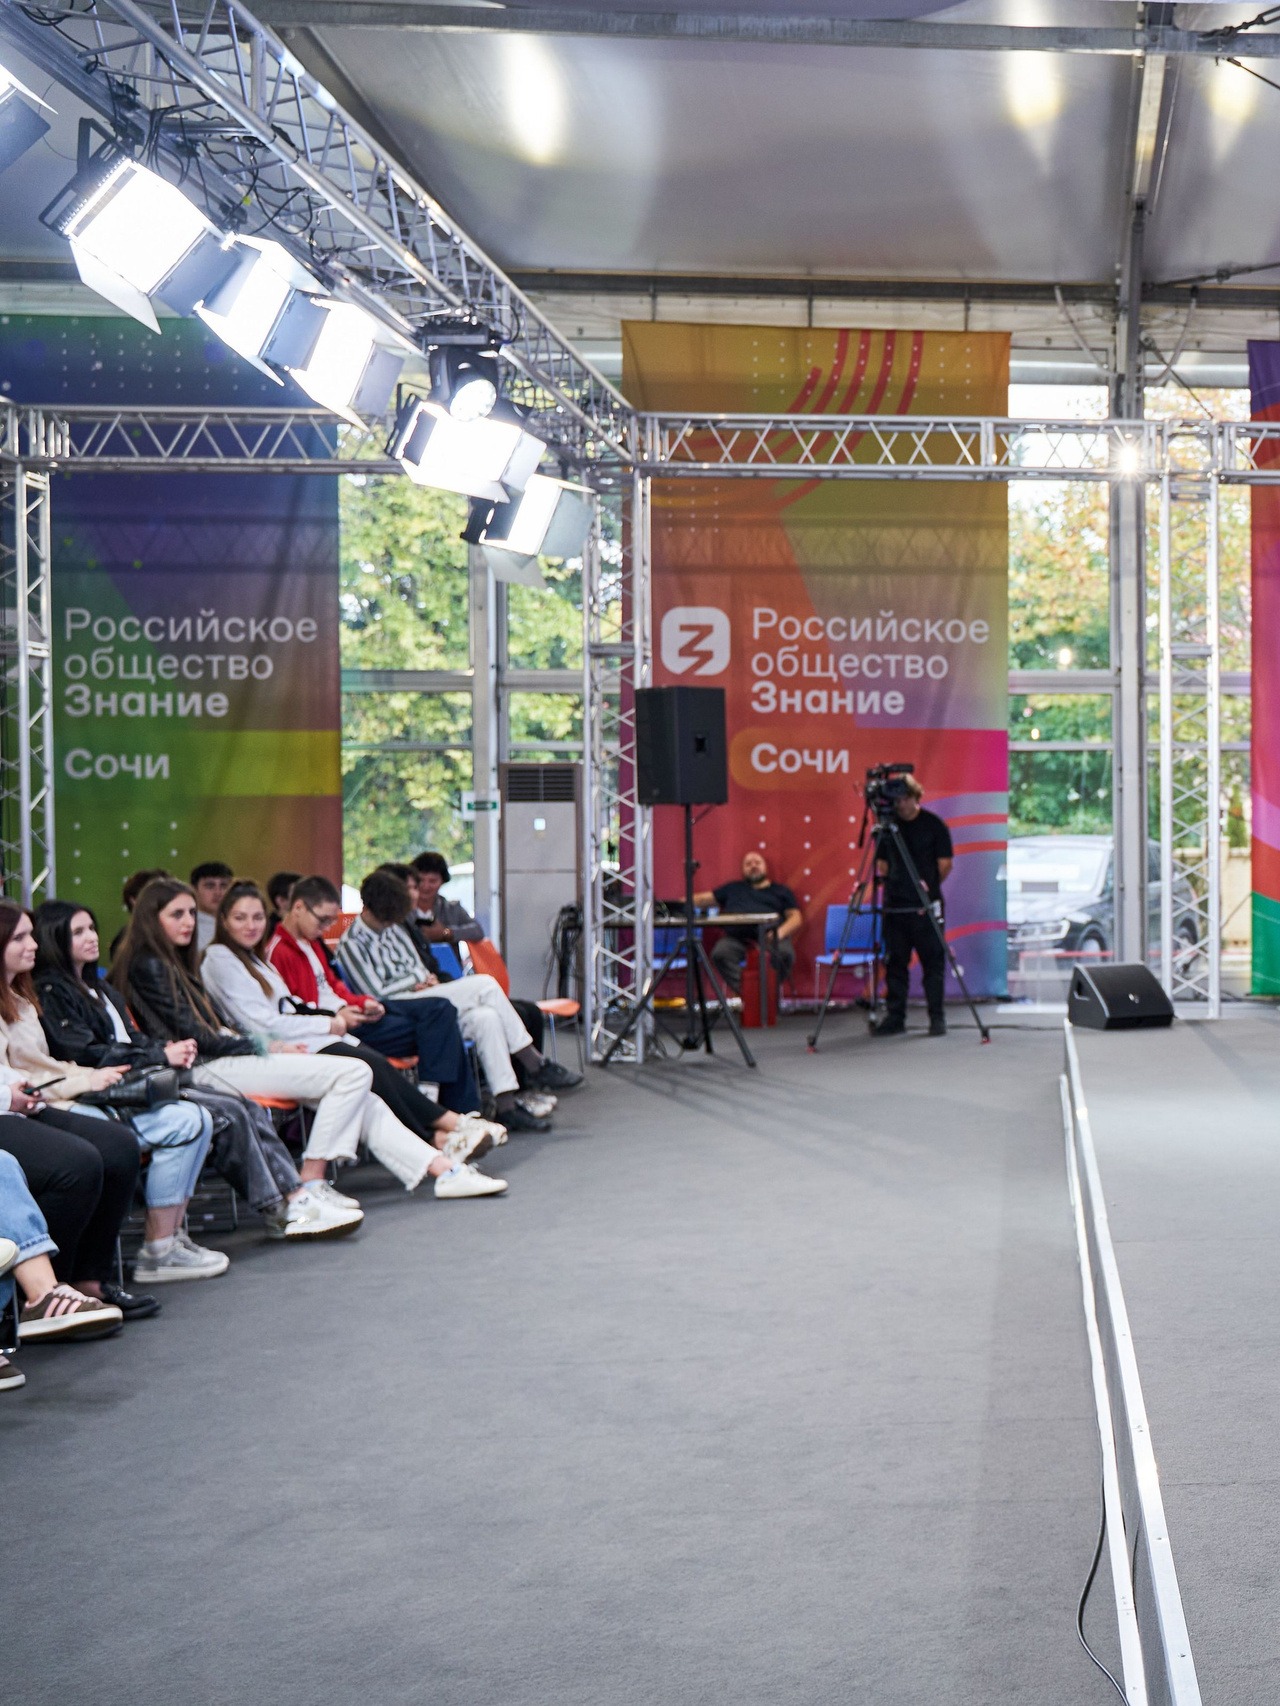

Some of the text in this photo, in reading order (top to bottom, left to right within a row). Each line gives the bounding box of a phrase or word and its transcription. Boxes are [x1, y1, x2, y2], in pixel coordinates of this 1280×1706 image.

[64, 608, 318, 643] Российское
[752, 607, 990, 643] Российское
[64, 647, 274, 684] общество
[750, 645, 949, 682] общество
[64, 684, 230, 717] Знание
[750, 681, 905, 714] Знание
[64, 748, 170, 779] Сочи
[750, 743, 849, 773] Сочи
